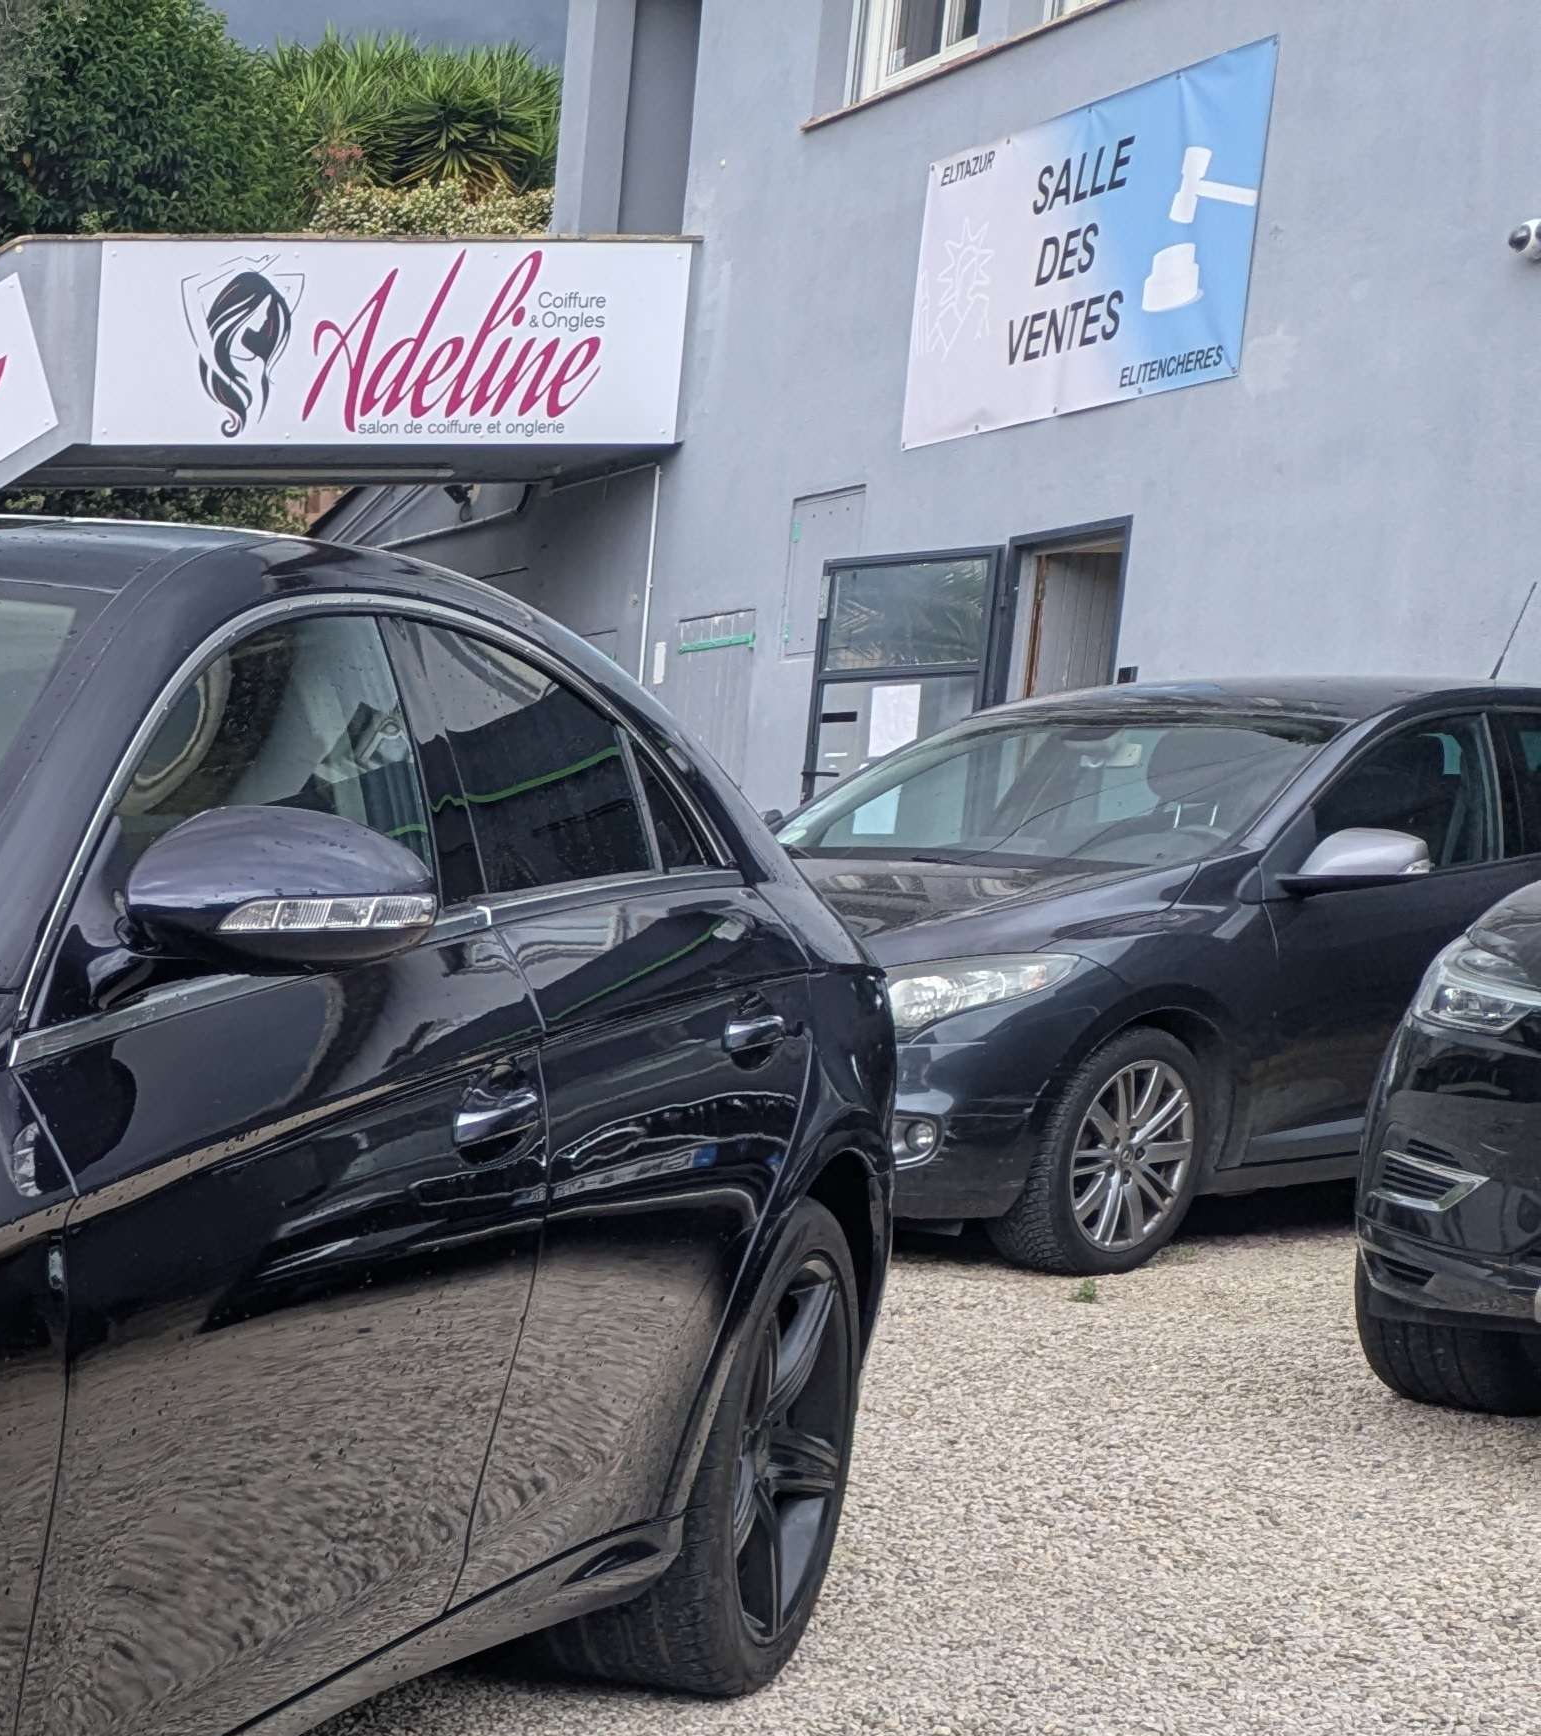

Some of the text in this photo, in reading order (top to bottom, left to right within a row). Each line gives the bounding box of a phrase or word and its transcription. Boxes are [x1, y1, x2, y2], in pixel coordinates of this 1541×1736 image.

[940, 150, 996, 187] ELITAZUR
[1032, 136, 1135, 216] SALLE
[1034, 222, 1099, 287] DES
[538, 291, 607, 309] Coiffure
[542, 311, 606, 332] Ongles
[301, 248, 602, 433] Adeline
[1007, 290, 1124, 366] VENTES
[1119, 344, 1224, 388] ELITENCHERES
[358, 419, 566, 437] salon de coiffure et onglerie
